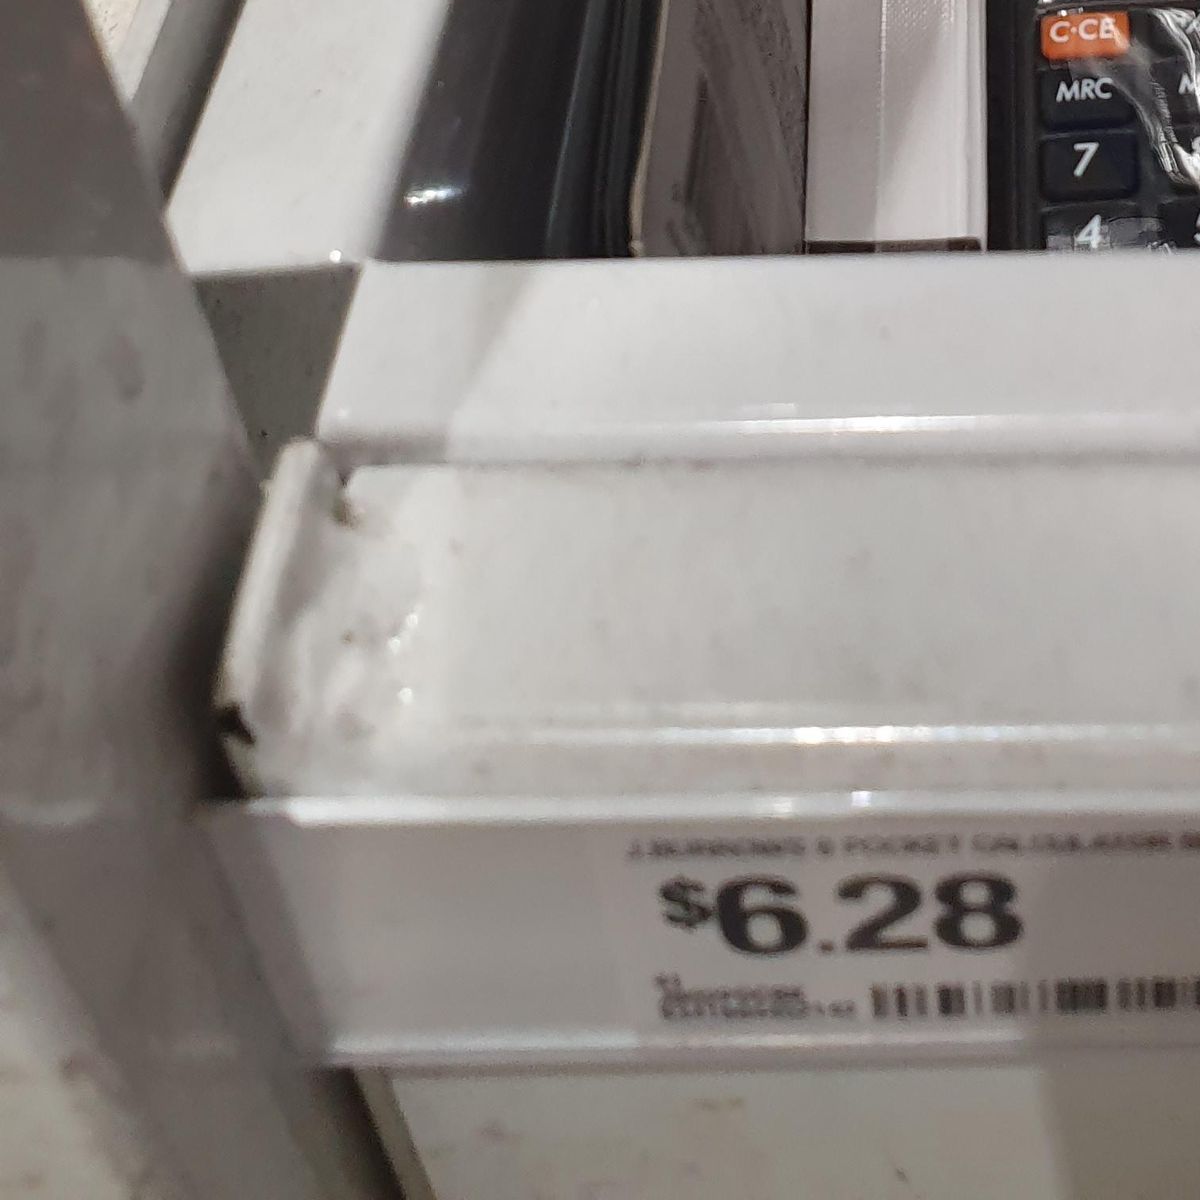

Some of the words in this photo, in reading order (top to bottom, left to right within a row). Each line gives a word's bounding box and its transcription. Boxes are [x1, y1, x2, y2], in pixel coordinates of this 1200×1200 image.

[1056, 77, 1113, 102] MRC
[1073, 142, 1099, 178] 7
[1074, 214, 1101, 249] 4
[660, 873, 1024, 956] $6.28
